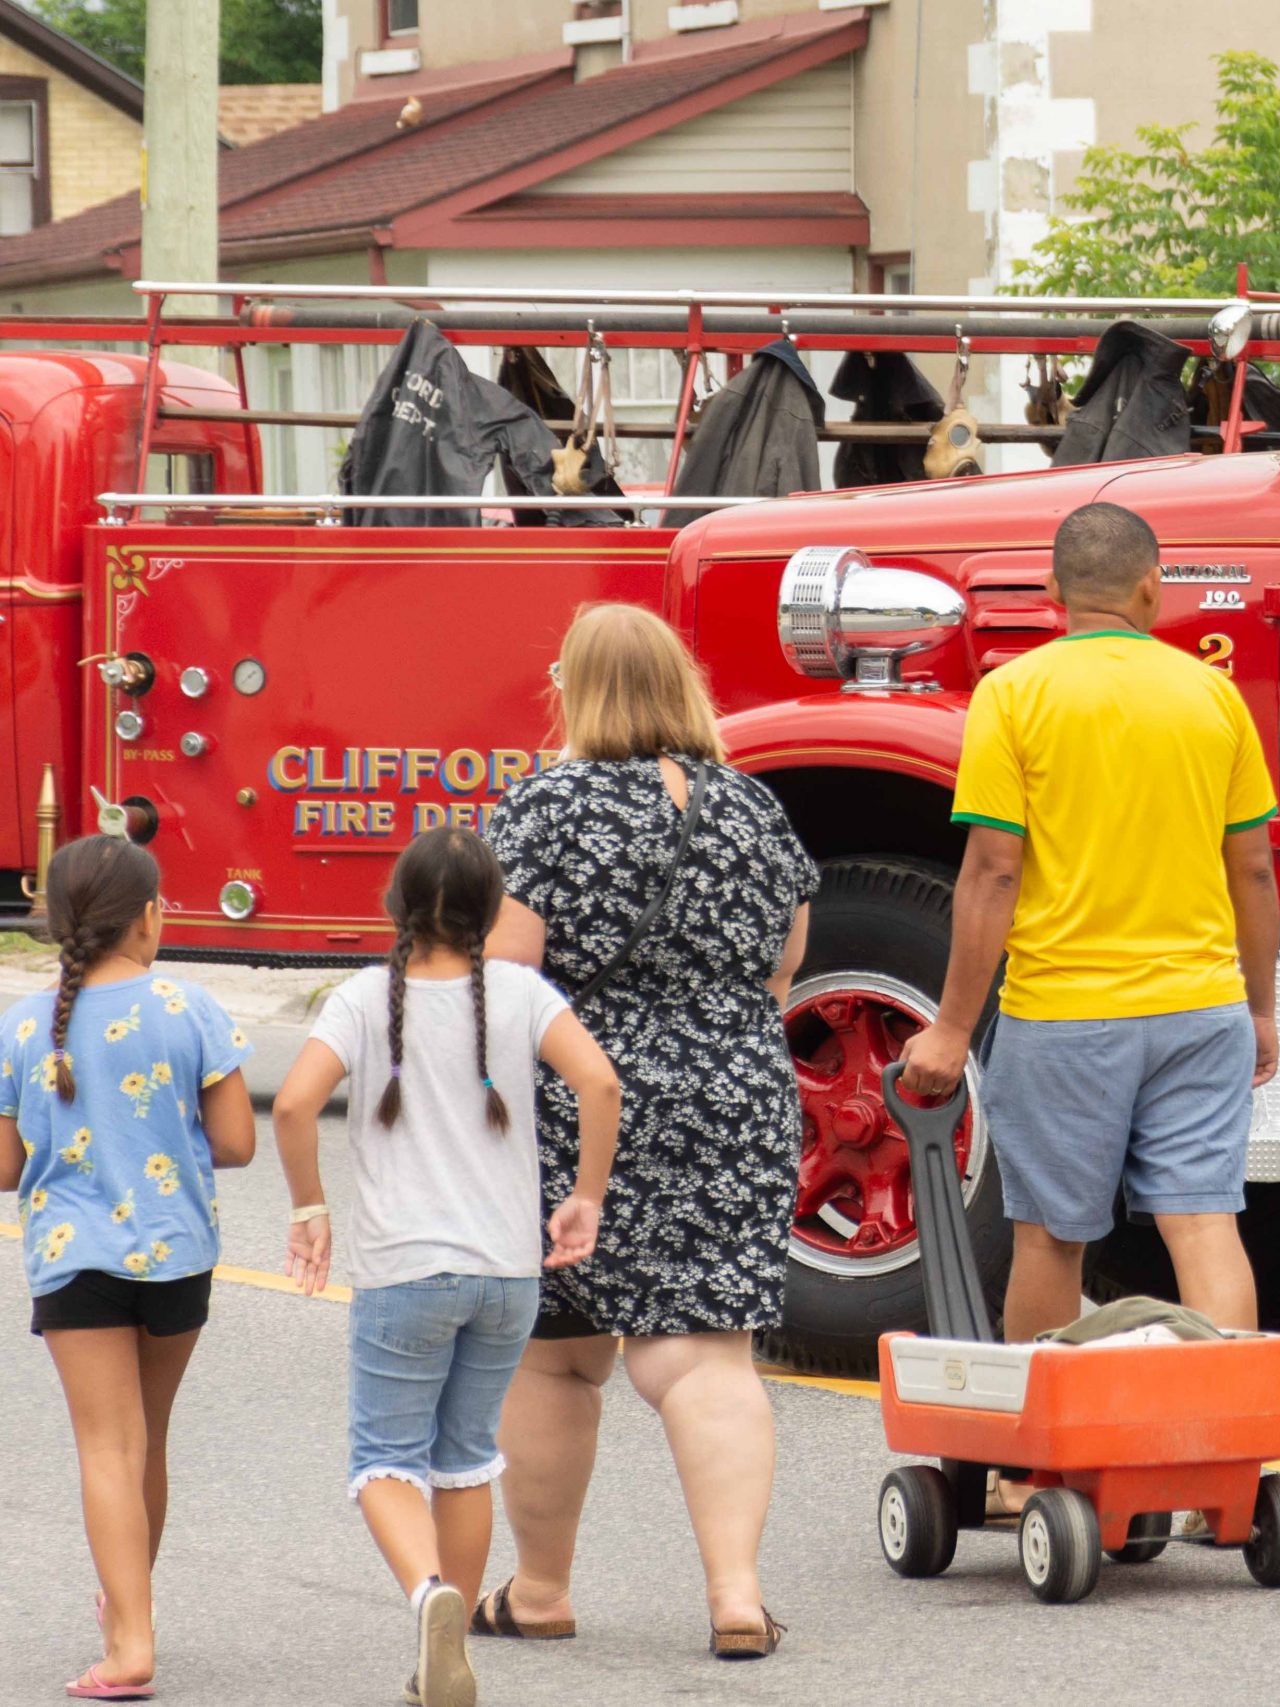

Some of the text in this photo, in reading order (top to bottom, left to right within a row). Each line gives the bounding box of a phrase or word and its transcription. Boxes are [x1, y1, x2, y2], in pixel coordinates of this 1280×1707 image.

[1205, 590, 1240, 606] 190
[1198, 633, 1233, 679] 2
[123, 749, 175, 761] BY-PASS
[294, 801, 395, 837] FIRE
[225, 867, 263, 880] TANK
